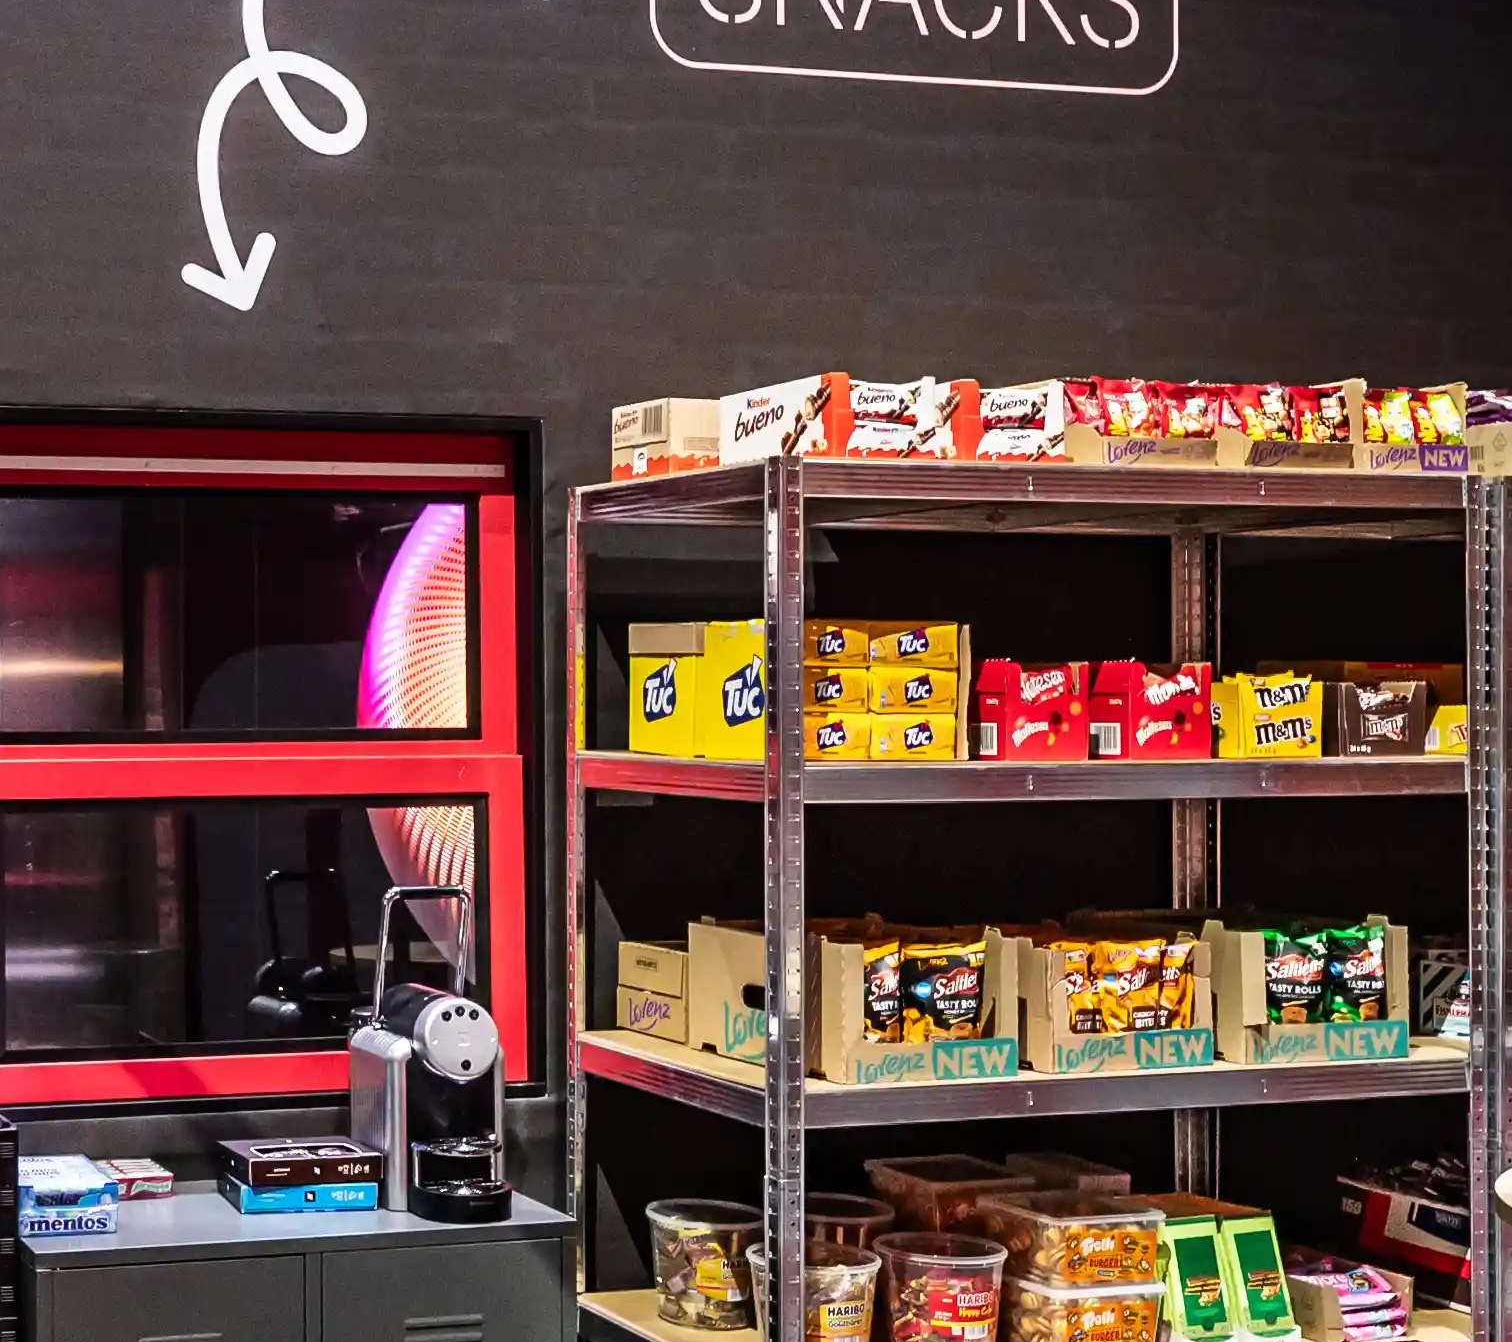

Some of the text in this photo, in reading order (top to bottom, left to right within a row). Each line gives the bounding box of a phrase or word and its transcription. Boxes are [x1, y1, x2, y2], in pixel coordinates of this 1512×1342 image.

[857, 392, 896, 405] bueno
[989, 398, 1028, 413] bueno
[734, 405, 784, 441] bueno
[1108, 440, 1157, 464] Lorenz
[1370, 446, 1467, 470] Lorenz NEW
[818, 632, 844, 652] TUC
[899, 634, 927, 653] TUC
[643, 678, 672, 715] TUC
[723, 681, 762, 718] TUC
[815, 681, 841, 699] TUC
[905, 681, 931, 699] TUC
[817, 728, 844, 747] TUC
[905, 728, 931, 746] TUC
[1269, 983, 1322, 994] TASTY ROLLS
[936, 1000, 957, 1009] TASTY
[628, 998, 671, 1031] Lorenz
[1329, 1026, 1398, 1057] NEW
[1057, 1035, 1209, 1073] Lorenz NEW
[856, 1045, 1010, 1085] Lorenz NEW
[1341, 1198, 1362, 1215] 150
[30, 1215, 108, 1231] mentos
[1080, 1237, 1114, 1256] Trolli
[827, 1304, 865, 1316] HARIBO
[1082, 1310, 1115, 1331] Trolli
